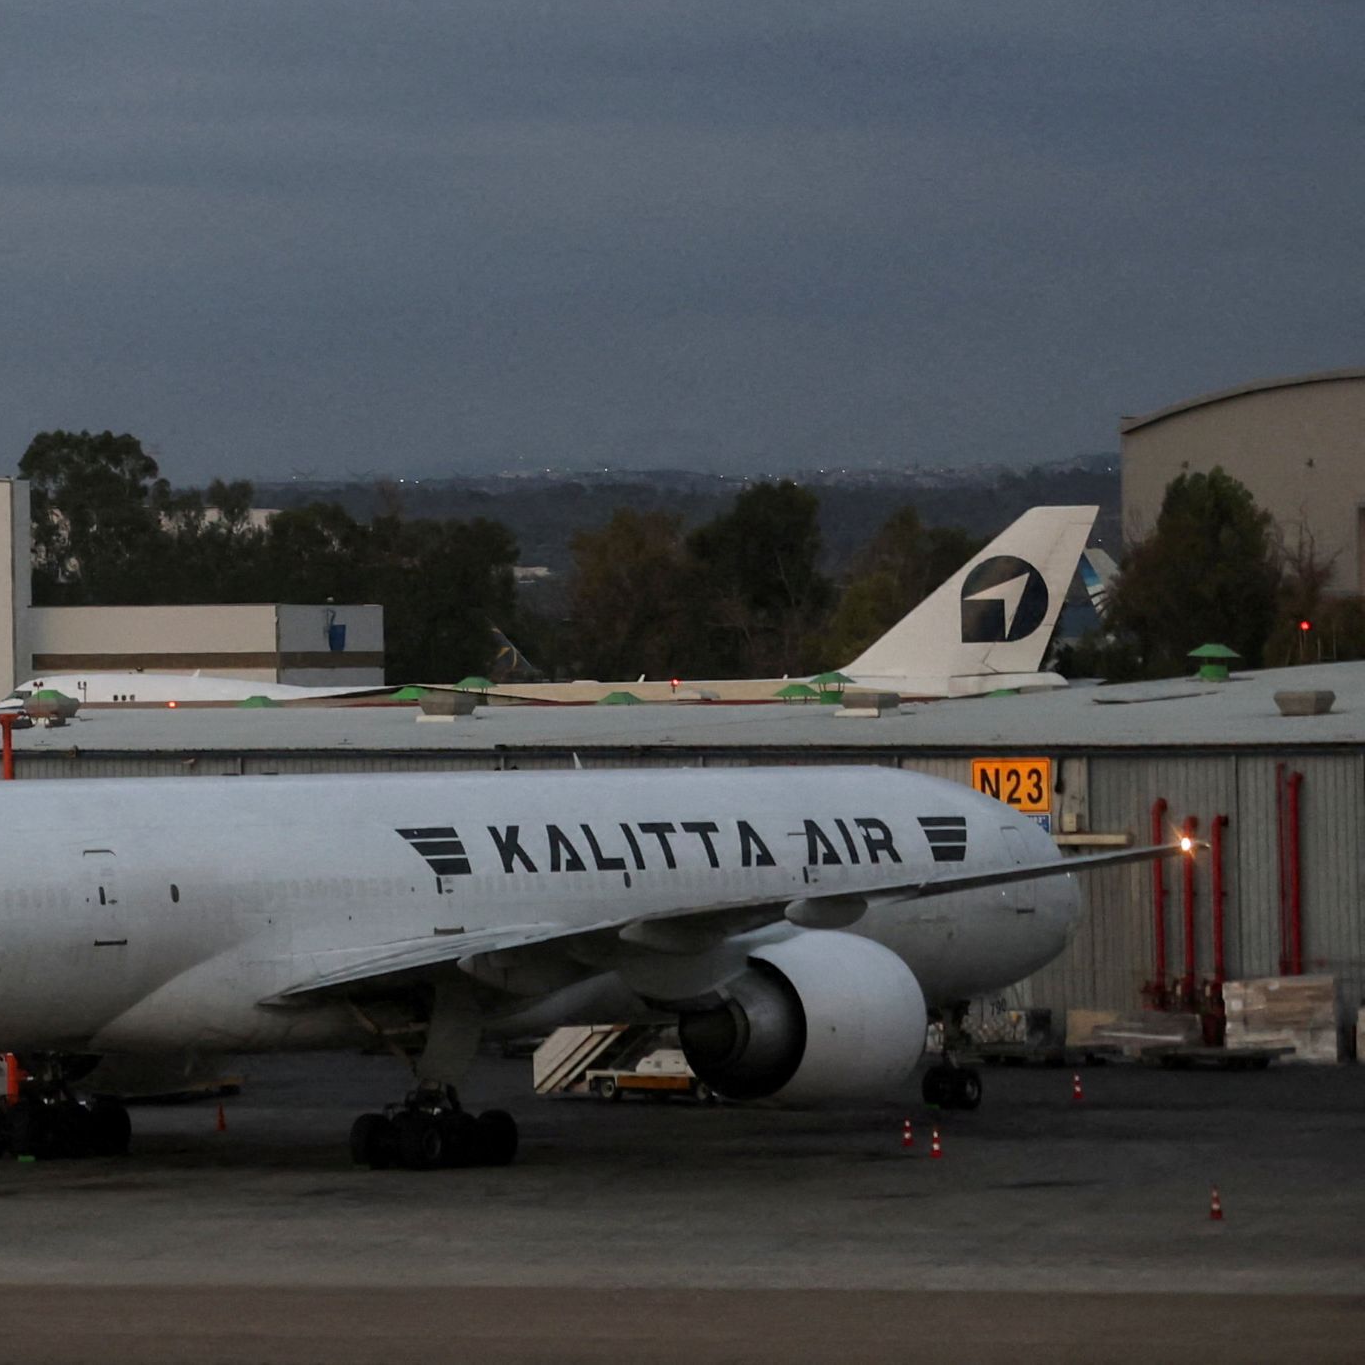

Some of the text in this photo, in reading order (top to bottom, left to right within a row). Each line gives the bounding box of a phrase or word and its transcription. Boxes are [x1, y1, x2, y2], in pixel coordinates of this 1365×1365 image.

[980, 767, 1043, 804] N23
[487, 817, 903, 873] KALITTA AIR
